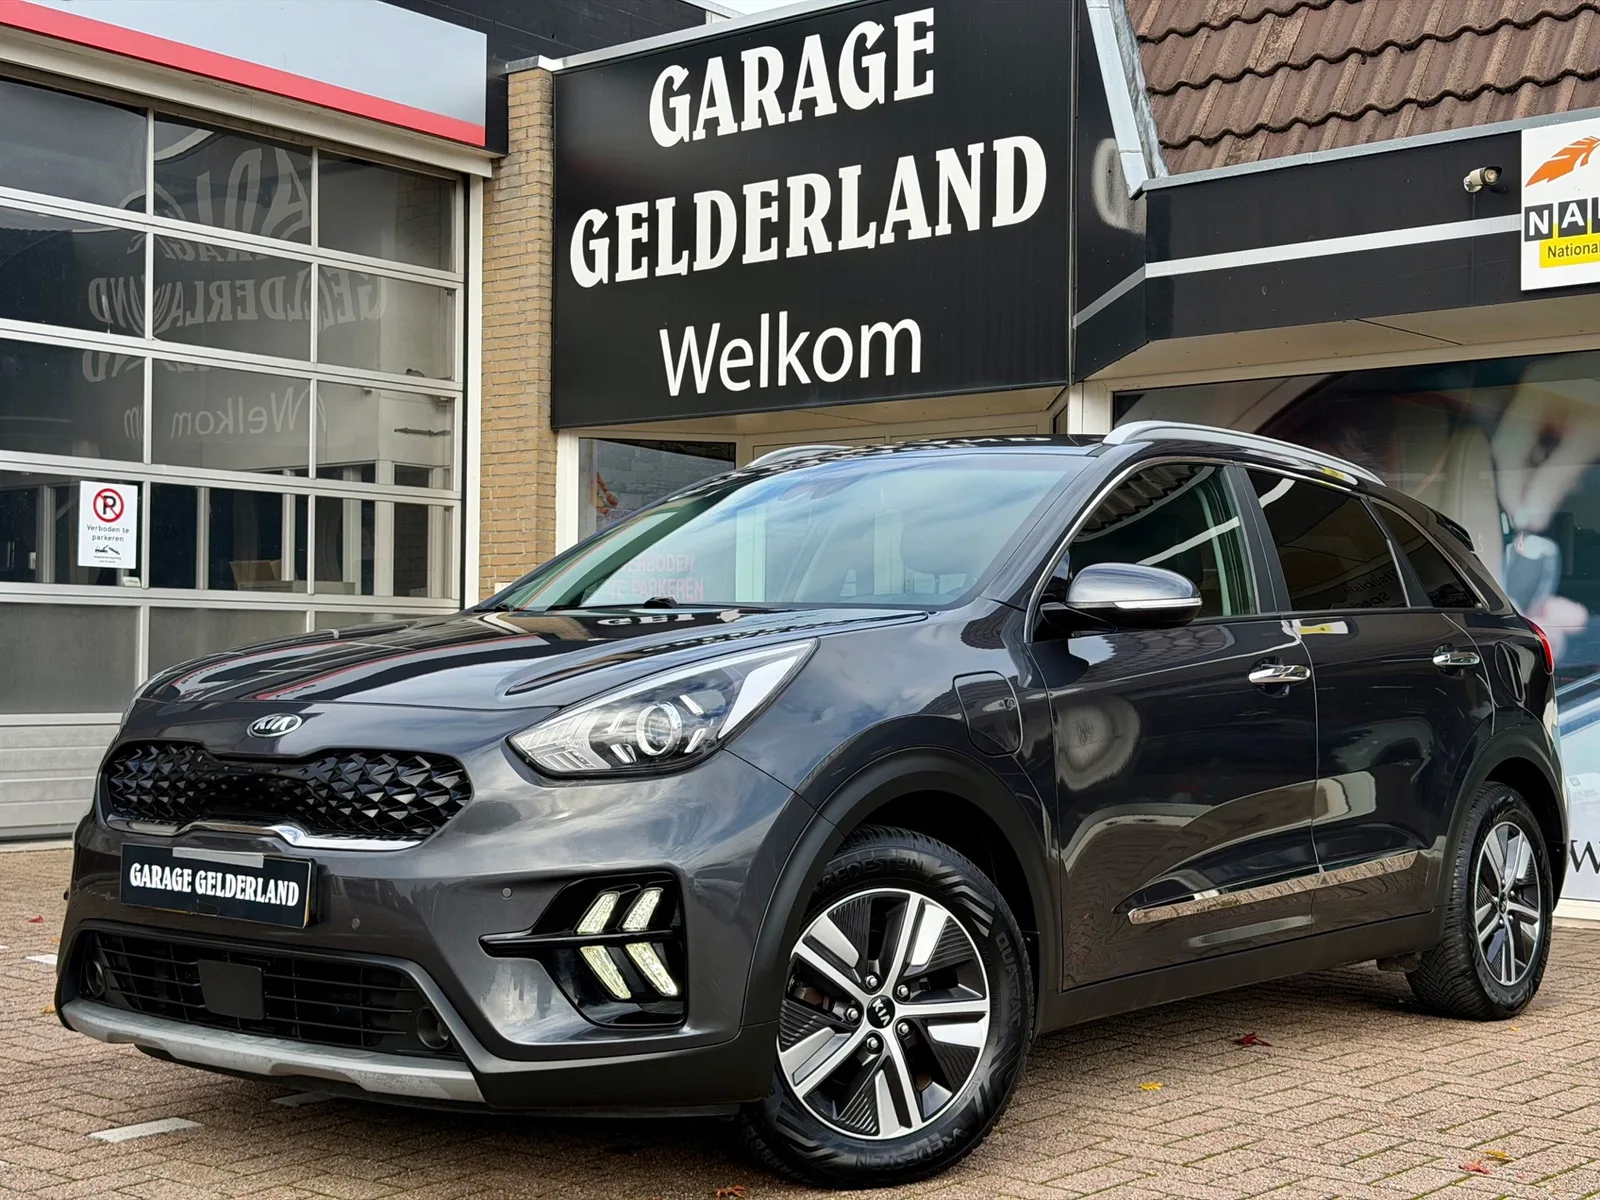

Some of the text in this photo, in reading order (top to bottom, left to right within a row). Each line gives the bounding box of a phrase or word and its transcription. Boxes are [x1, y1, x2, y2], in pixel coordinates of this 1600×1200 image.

[648, 8, 935, 147] GARAGE
[570, 135, 1048, 288] GELDERLAND
[1529, 200, 1600, 236] NA
[659, 311, 922, 397] Welkom
[86, 524, 120, 533] Verboden
[91, 534, 124, 542] parkeren
[622, 554, 696, 573] ERBODEN
[252, 715, 297, 732] KIA
[129, 862, 300, 907] GARAGE GELDERLAND
[872, 998, 890, 1026] KIA
